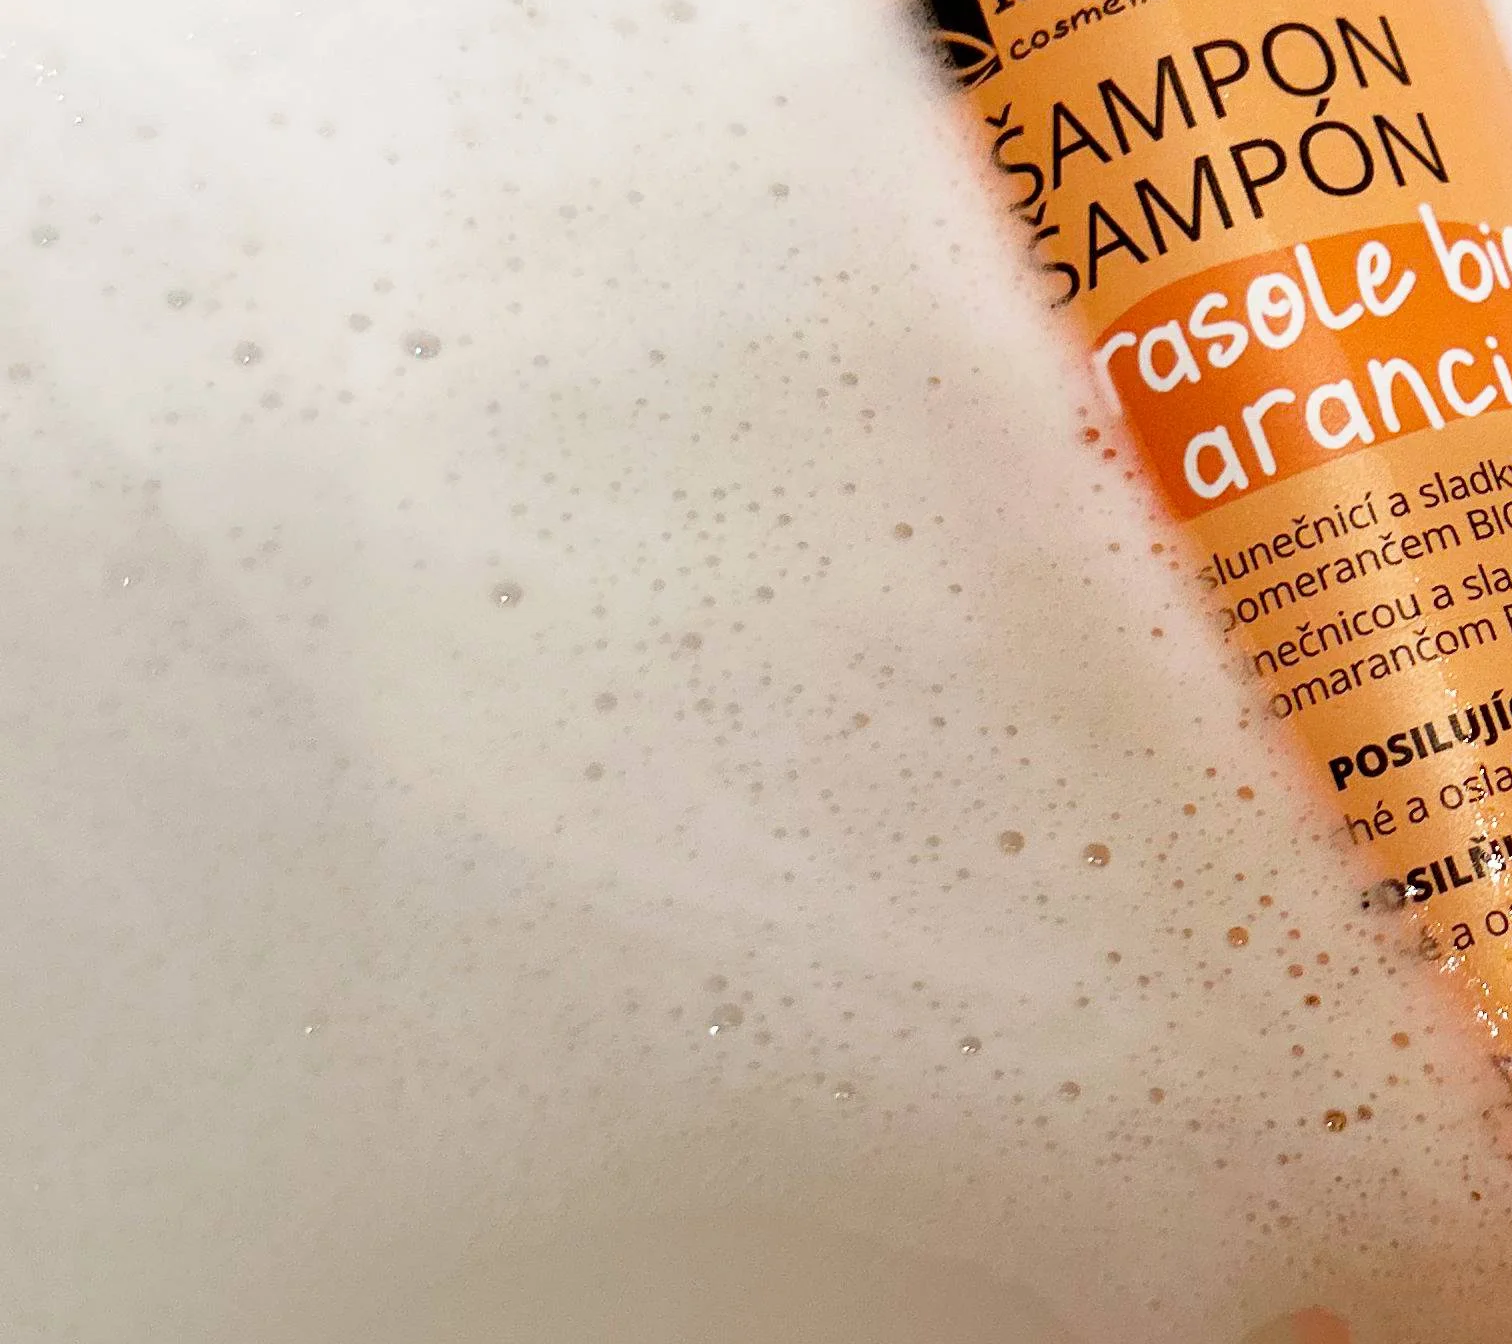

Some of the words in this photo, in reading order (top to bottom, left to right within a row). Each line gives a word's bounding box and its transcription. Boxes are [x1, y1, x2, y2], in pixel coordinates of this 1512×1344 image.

[984, 15, 1411, 212] ŠAMPON
[1020, 99, 1449, 308] ŠAMPÓN
[1197, 492, 1378, 589] slunečnicí
[1388, 492, 1411, 518] a
[1431, 584, 1454, 610] a
[1335, 800, 1397, 846] hé
[1406, 797, 1429, 824] a
[1451, 922, 1475, 950] a
